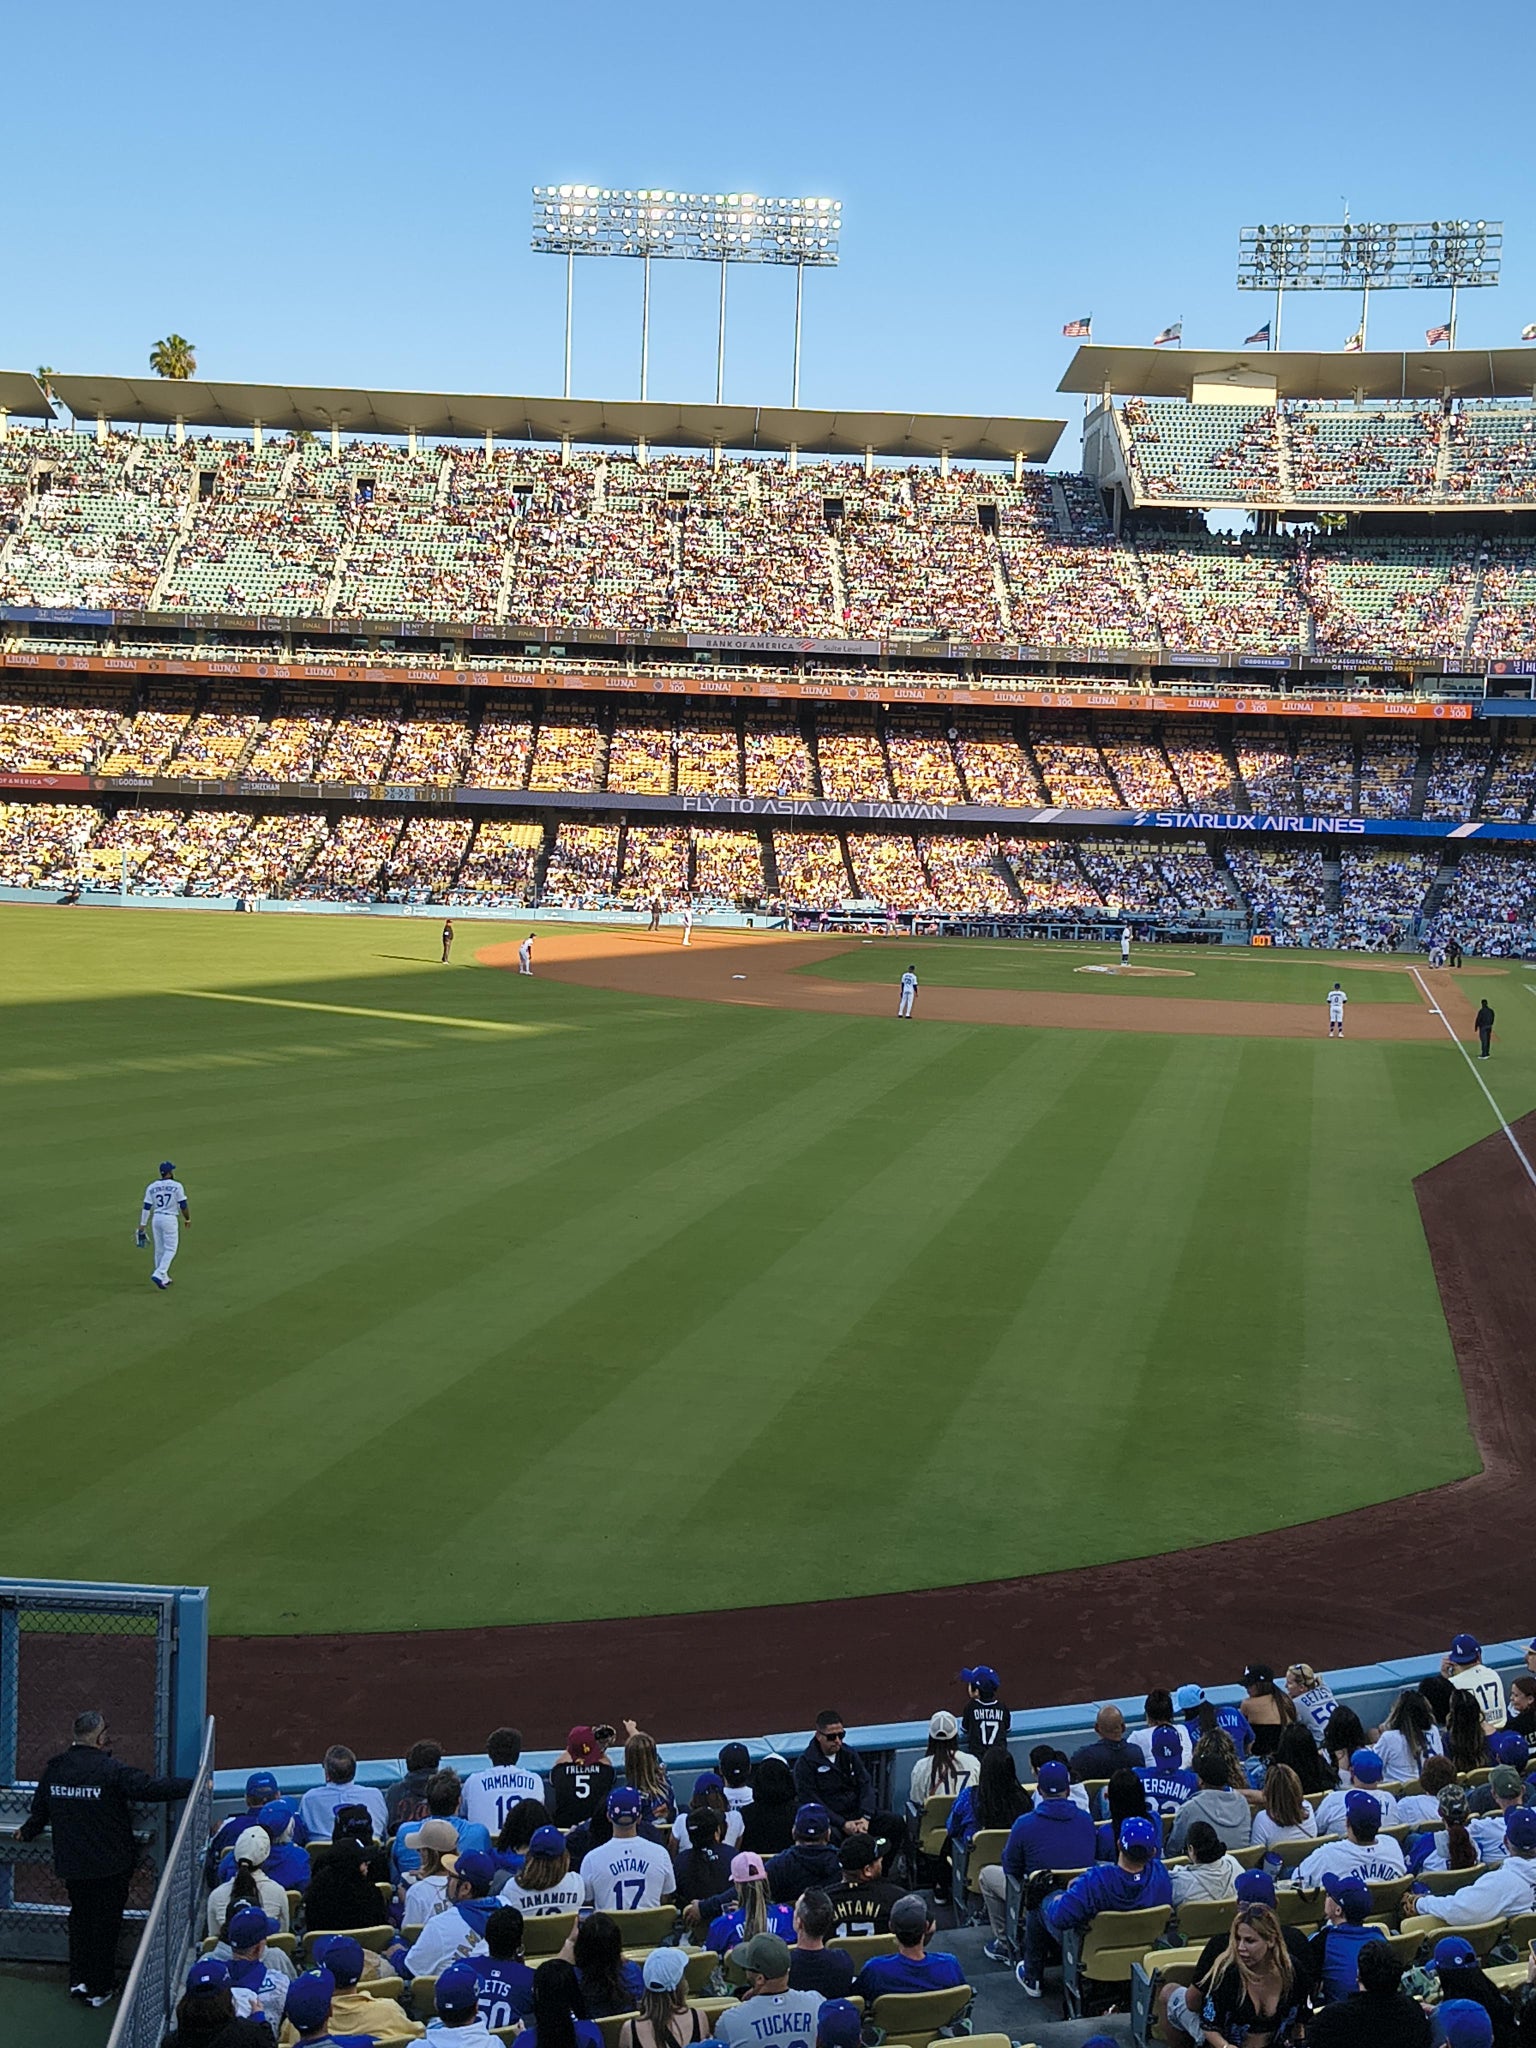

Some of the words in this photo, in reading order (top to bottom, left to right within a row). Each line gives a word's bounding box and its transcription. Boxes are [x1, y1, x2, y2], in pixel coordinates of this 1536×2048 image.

[706, 640, 732, 648] BANK
[735, 641, 747, 649] OF
[750, 642, 794, 650] AMERICA
[72, 662, 89, 670] 300
[274, 670, 290, 678] 300
[474, 677, 489, 685] 300
[864, 692, 880, 700] 300
[1251, 705, 1268, 713] 300
[1450, 710, 1467, 718] 300
[118, 778, 153, 786] GOODMAN
[251, 782, 280, 790] SHEEHAN
[683, 797, 722, 811] FLY
[727, 798, 754, 813] TO
[761, 800, 815, 815] ASIA
[822, 801, 858, 817] VIA
[864, 803, 949, 820] TAIWAN
[1155, 812, 1257, 830] STARLUX
[1261, 816, 1365, 834] AIRLINES
[155, 1193, 171, 1207] 37
[1301, 1687, 1329, 1707] BETTS
[1476, 1681, 1498, 1710] 17
[973, 1708, 1004, 1721] OHTANI
[979, 1721, 999, 1745] 17
[50, 1785, 101, 1798] SECURITY
[481, 1773, 534, 1792] YAMAMOTO
[575, 1775, 590, 1799] 5
[1141, 1778, 1191, 1800] ERSHAW
[609, 1858, 649, 1876] OHTANI
[519, 1892, 577, 1908] YAMAMOTO
[613, 1878, 646, 1910] 17
[735, 1917, 778, 1939] ONI
[480, 1979, 512, 1997] ETTS
[474, 1998, 511, 2029] 50
[750, 2012, 812, 2040] TUCKER
